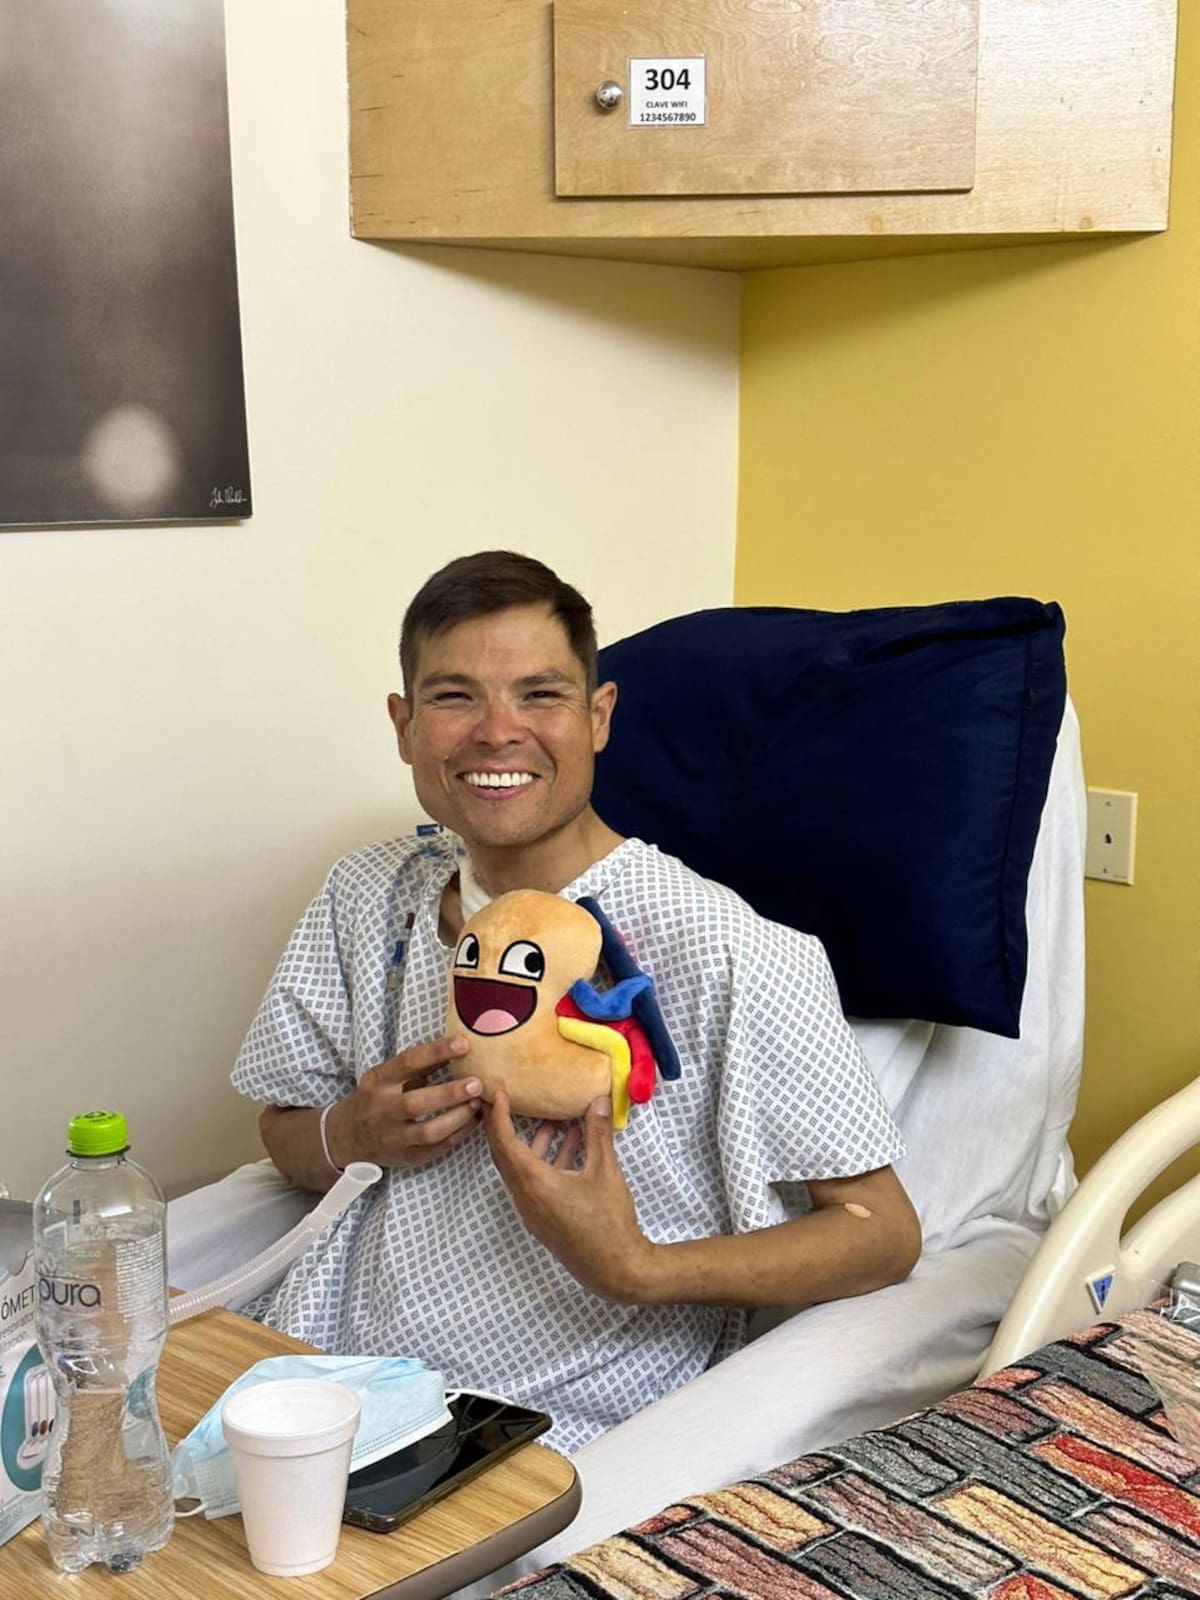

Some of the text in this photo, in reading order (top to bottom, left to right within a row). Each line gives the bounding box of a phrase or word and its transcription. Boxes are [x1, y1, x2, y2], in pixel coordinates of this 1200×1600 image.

[644, 68, 691, 91] 304
[645, 100, 688, 109] CLAVE WIFI
[640, 112, 696, 122] 1234567890
[38, 1278, 102, 1307] pura
